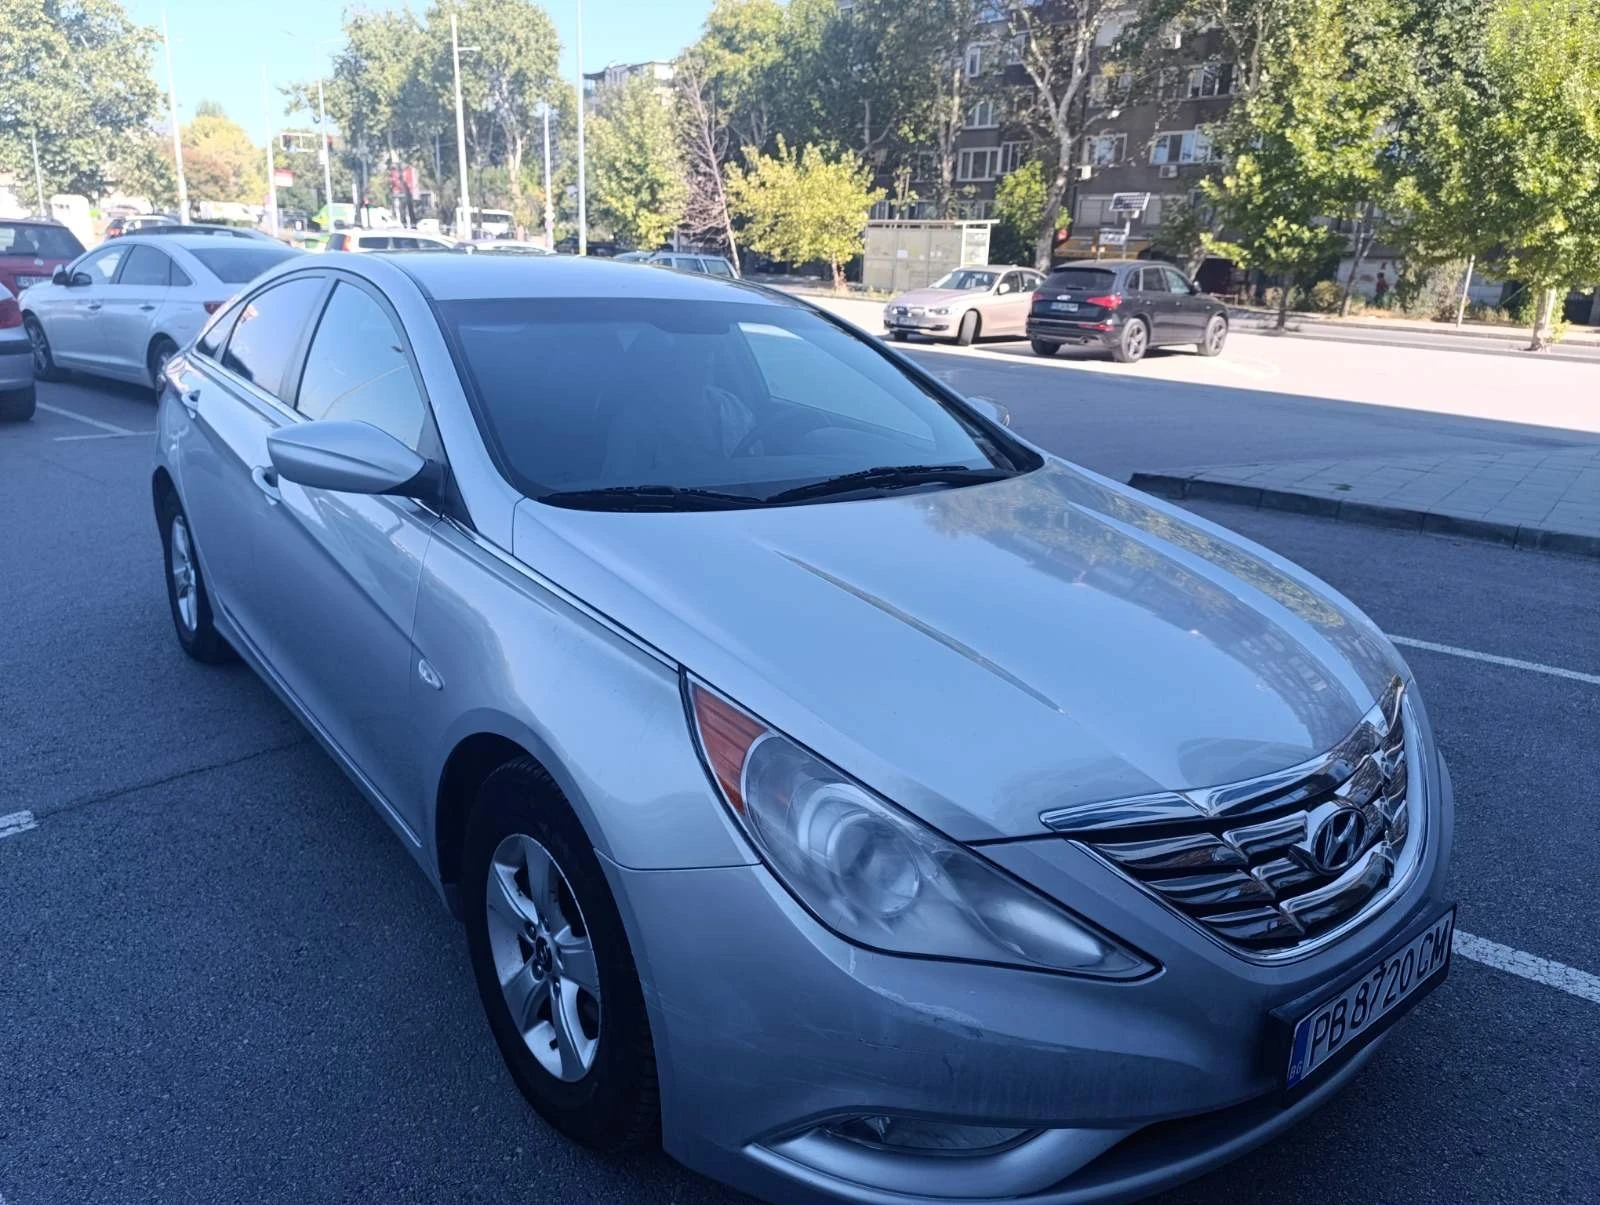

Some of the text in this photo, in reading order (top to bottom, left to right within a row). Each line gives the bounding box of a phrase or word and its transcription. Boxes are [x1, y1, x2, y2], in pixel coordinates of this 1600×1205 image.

[1308, 920, 1450, 1067] PB 8720 CM
